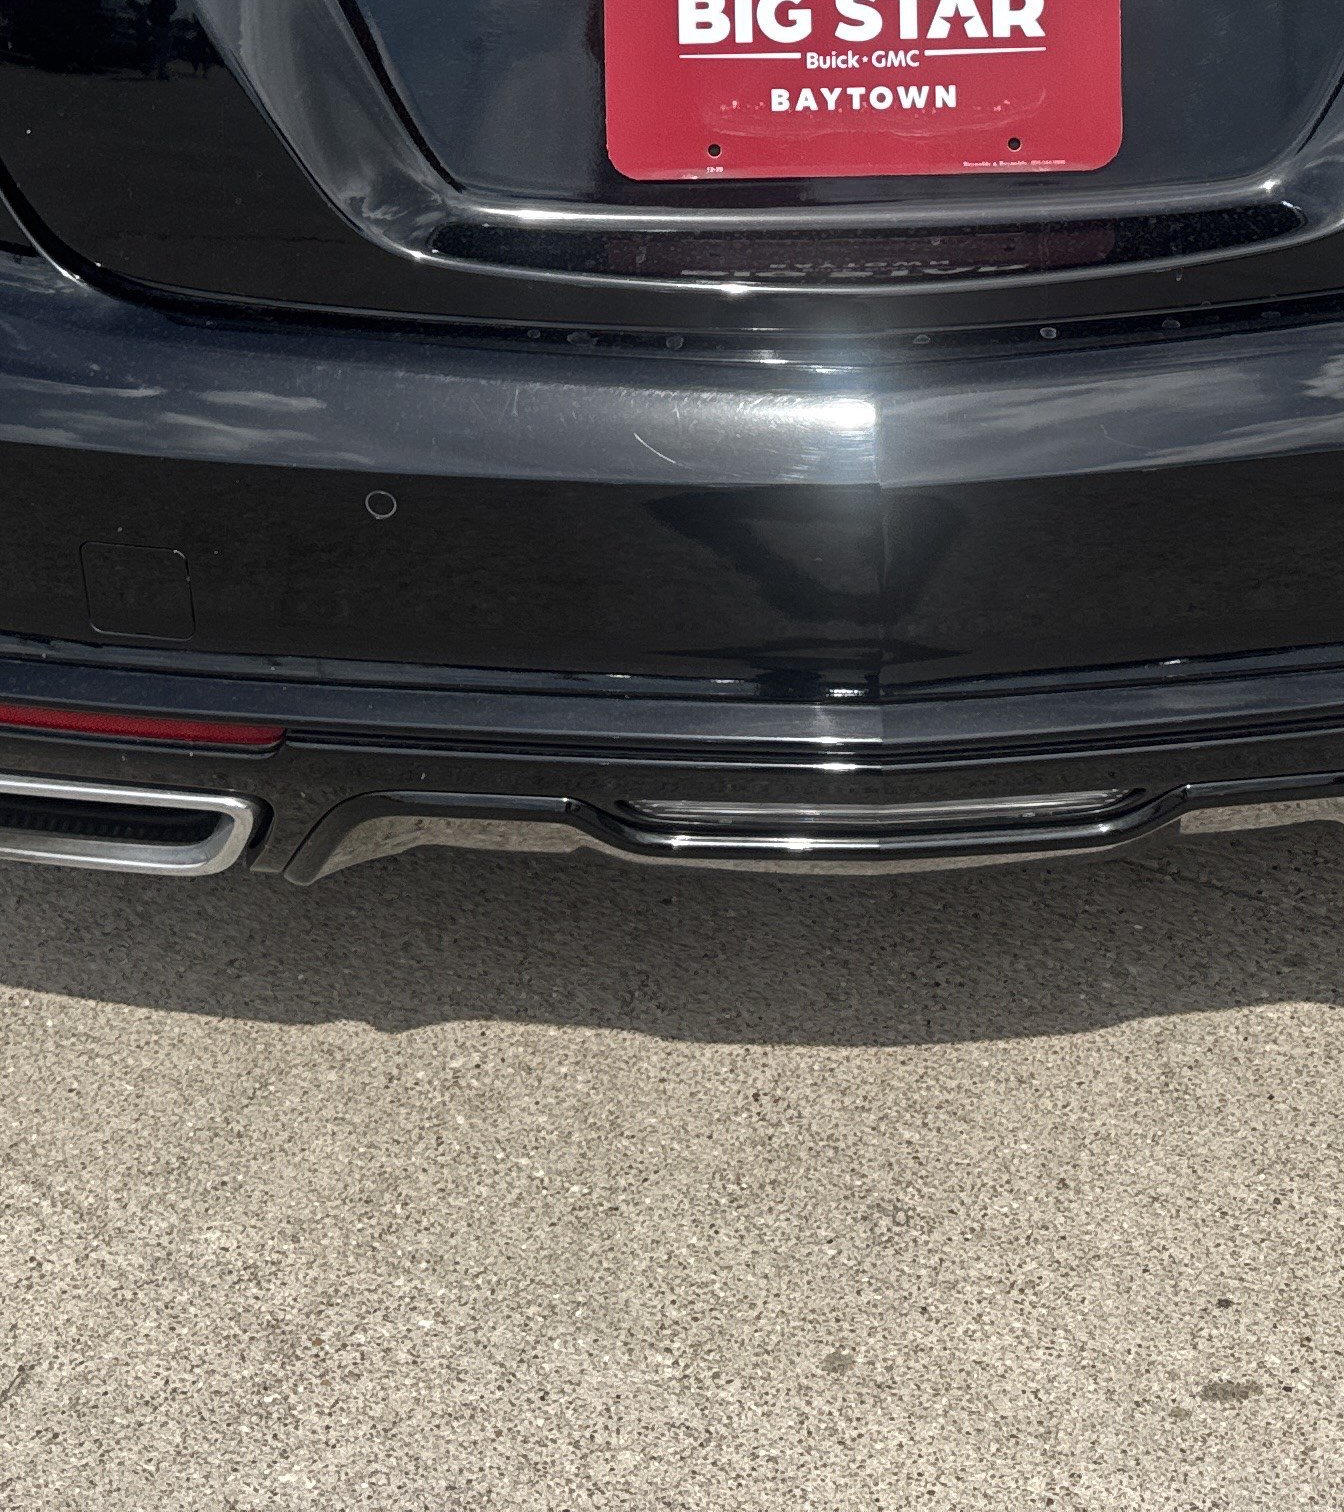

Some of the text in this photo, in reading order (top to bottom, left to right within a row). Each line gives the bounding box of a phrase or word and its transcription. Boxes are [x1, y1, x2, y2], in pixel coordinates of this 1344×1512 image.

[806, 50, 920, 69] Buick GMC
[771, 85, 957, 112] BAYTOWN
